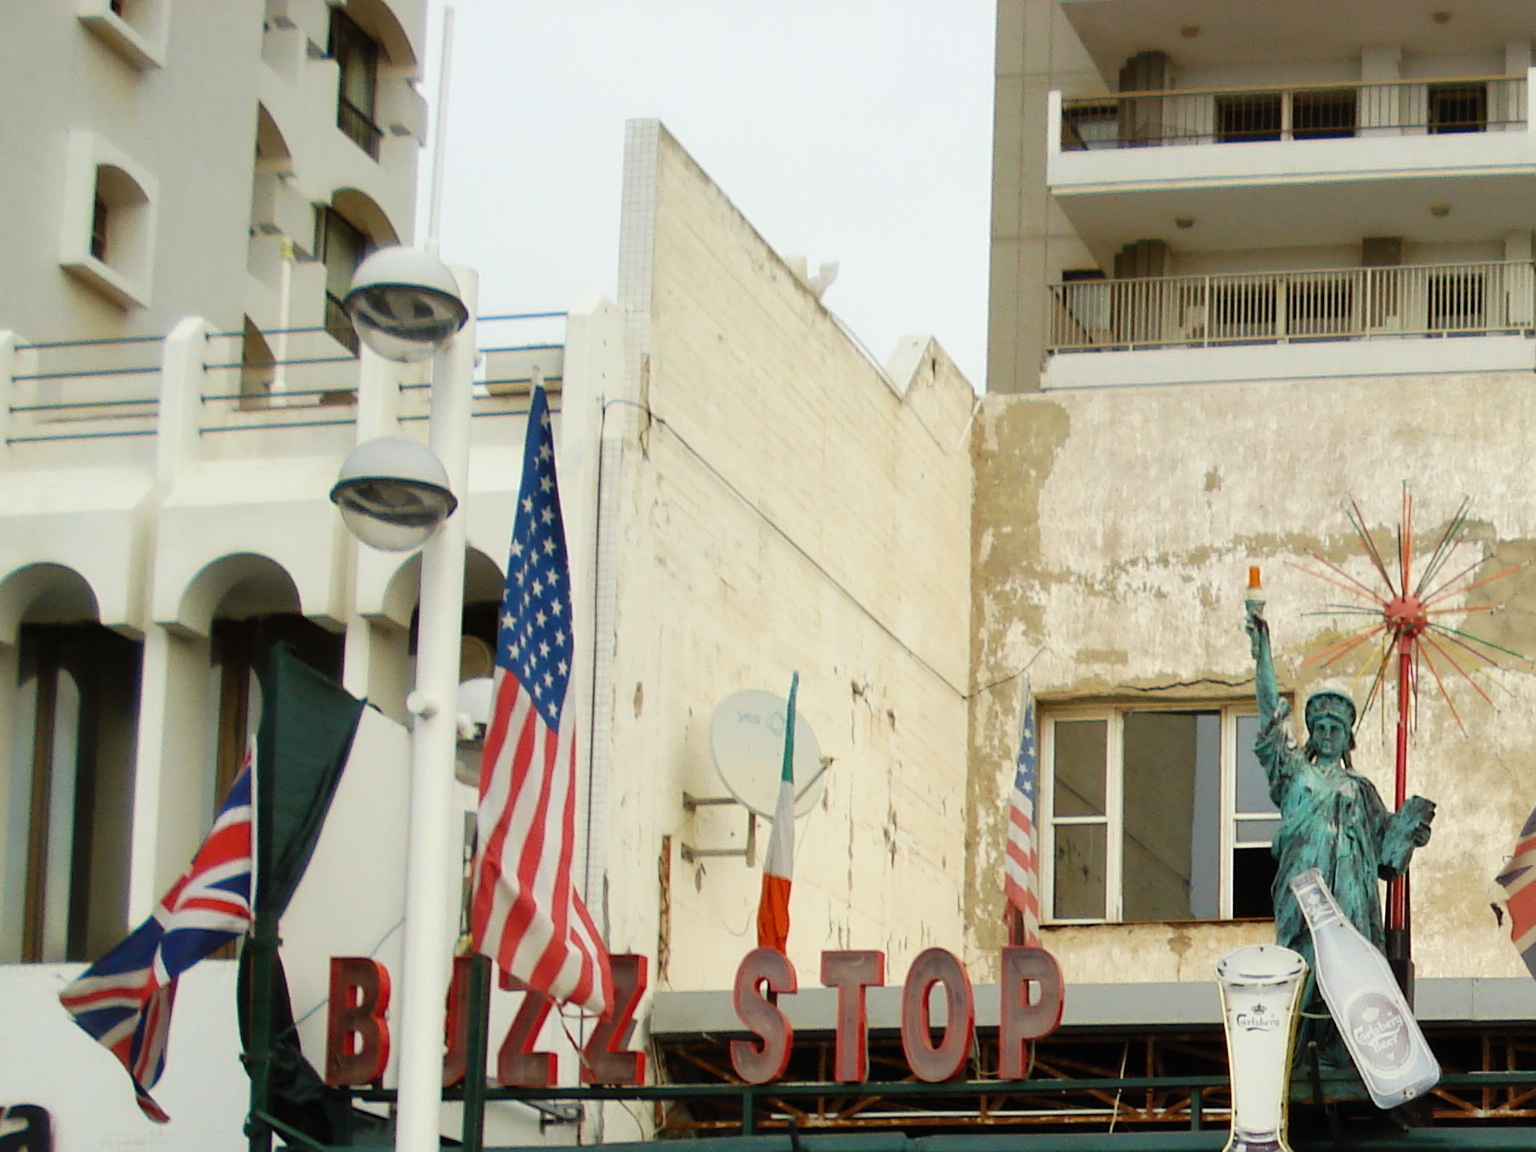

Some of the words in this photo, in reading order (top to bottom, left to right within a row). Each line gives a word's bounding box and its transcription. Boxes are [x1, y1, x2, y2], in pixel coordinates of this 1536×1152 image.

[730, 947, 1065, 1084] STOP
[1236, 1013, 1280, 1028] Carlsberg
[1353, 1015, 1404, 1044] Carlsberg
[1373, 1033, 1399, 1053] Beer
